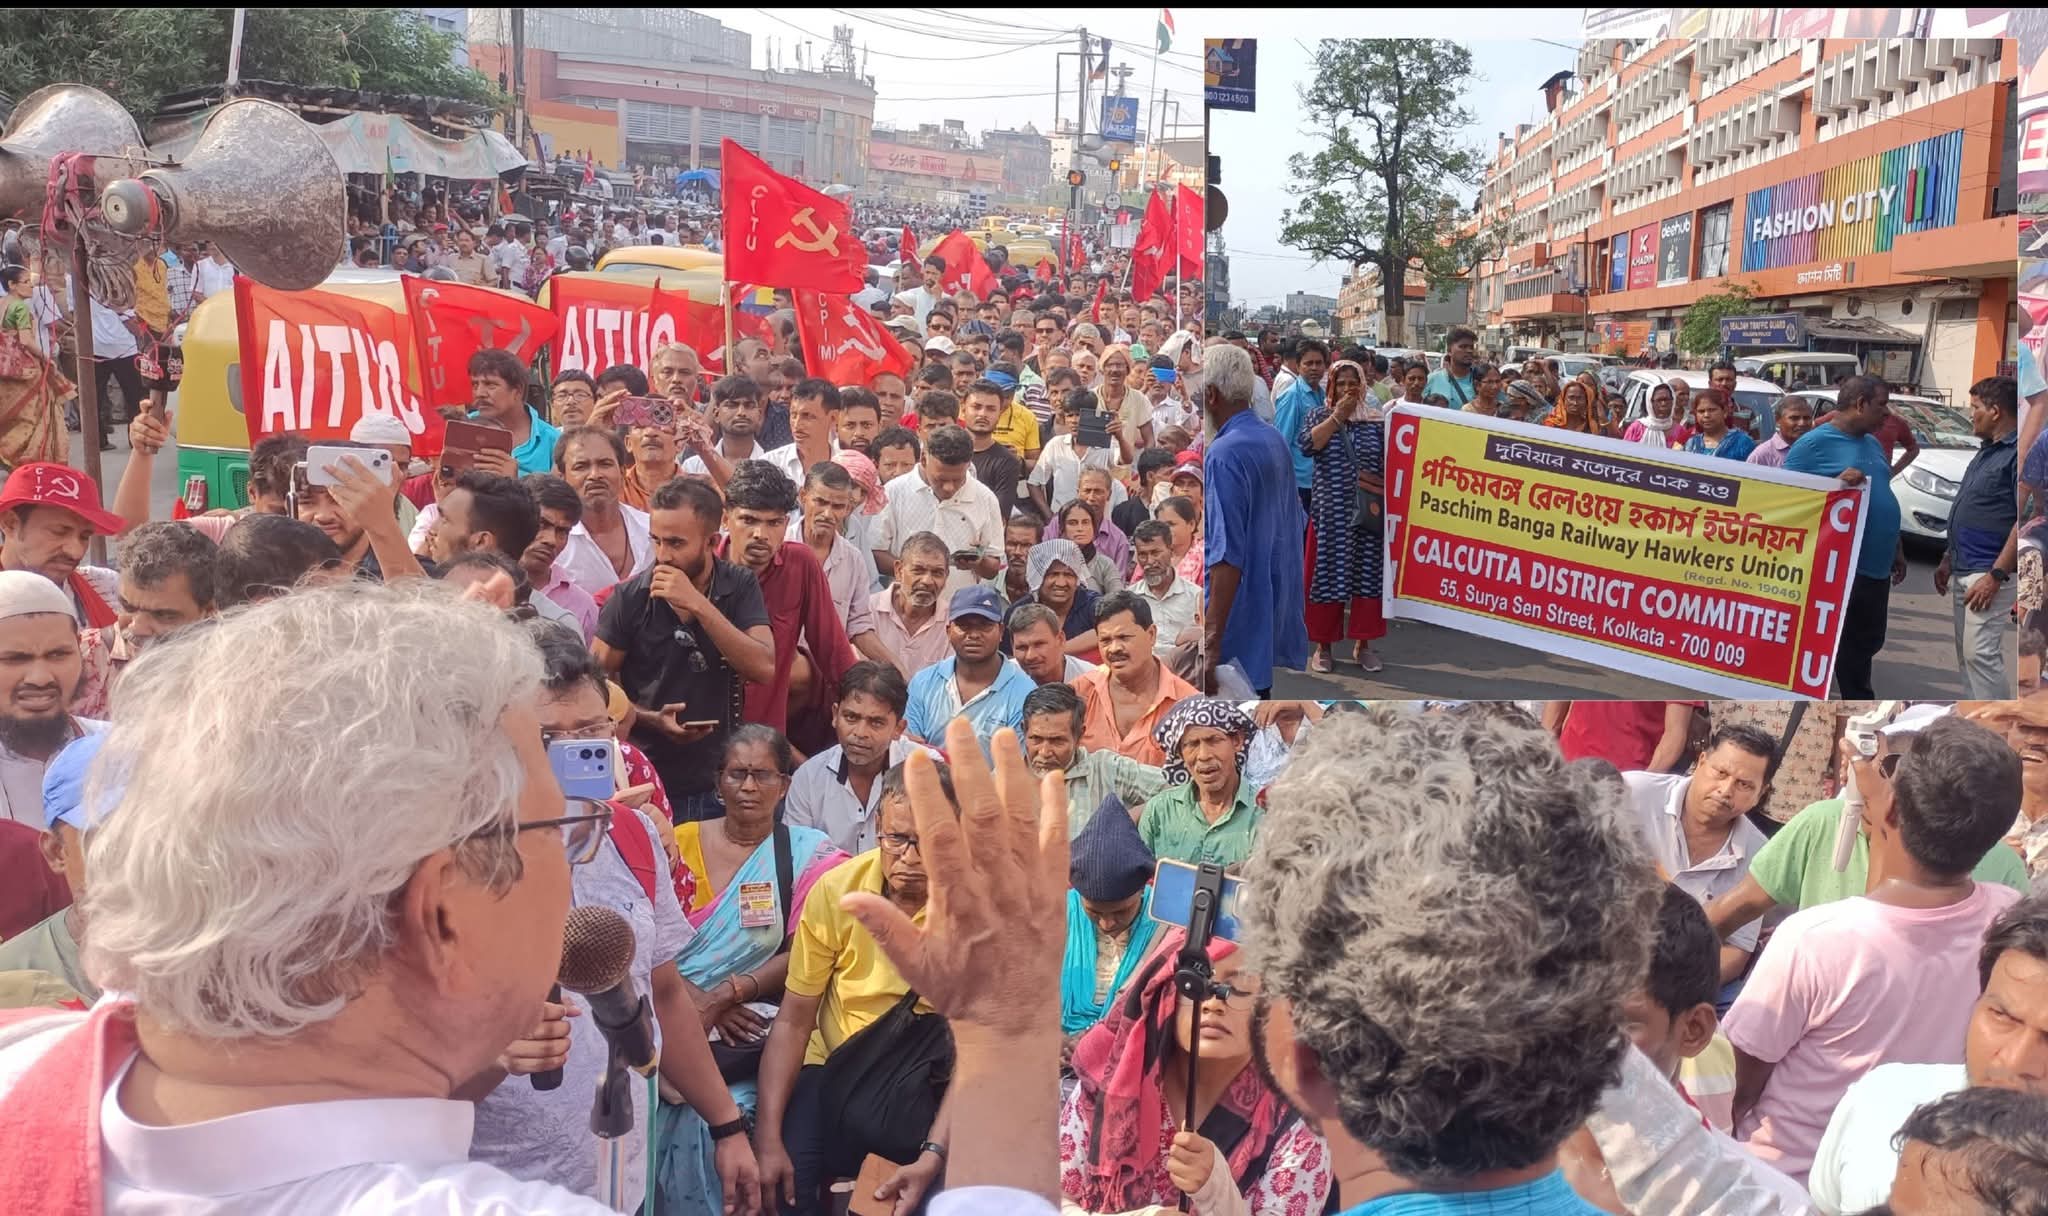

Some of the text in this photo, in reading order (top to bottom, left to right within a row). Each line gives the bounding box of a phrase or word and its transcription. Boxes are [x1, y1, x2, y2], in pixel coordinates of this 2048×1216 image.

[746, 185, 768, 251] CITU
[1752, 185, 1898, 243] FASHION CITY
[261, 320, 426, 434] AITUC
[421, 288, 445, 390] CITU
[1421, 456, 1808, 554] পশ্চিমবঙ্গ রেলওয়ে হকার্স ইউনিয়ন
[1496, 443, 1730, 499] দুনিয়ার মজদুর এক হও
[1420, 491, 1804, 585] Paschim Banga Railway Hawkers Union
[1413, 535, 1791, 644] CALCUTTA DISTRICT COMMITTEE
[1440, 578, 1460, 602] 55,
[1465, 584, 1508, 611] Surya
[1512, 596, 1541, 618] Sen
[1546, 603, 1597, 634] Street,
[1602, 616, 1665, 647] Kolkata
[1681, 633, 1710, 659] 700
[1714, 641, 1745, 667] 009
[1684, 571, 1801, 601] (Regd. No. 19046)
[1801, 498, 1854, 687] CITU
